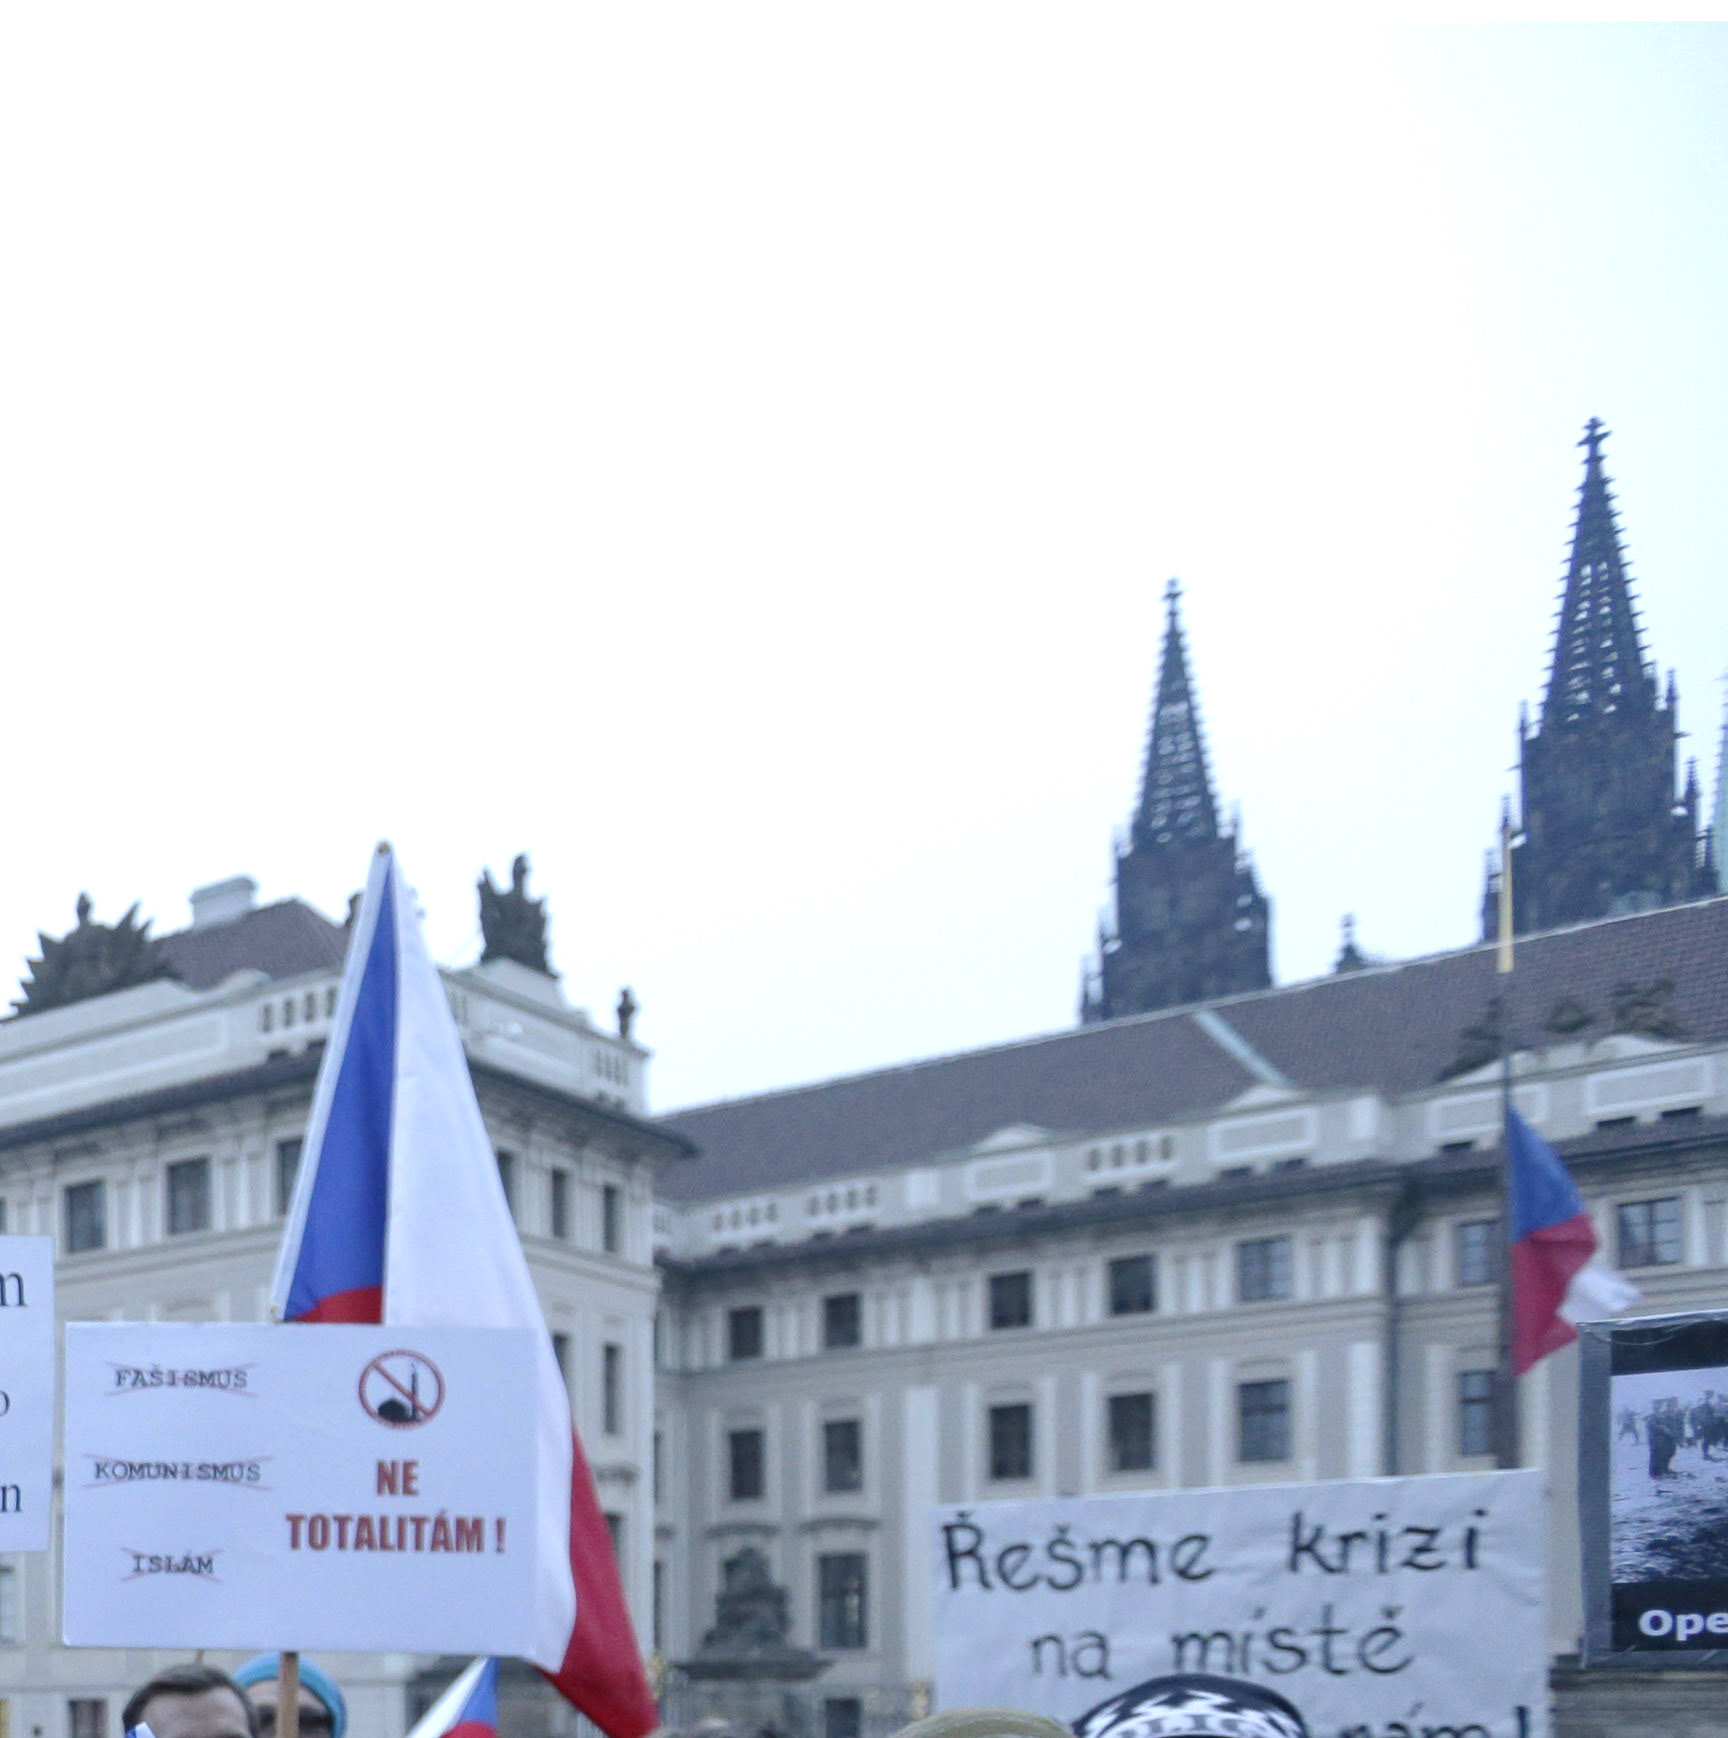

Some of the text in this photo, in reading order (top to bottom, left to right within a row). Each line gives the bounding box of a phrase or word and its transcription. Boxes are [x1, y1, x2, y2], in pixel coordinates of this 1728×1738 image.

[114, 1363, 249, 1389] FAŠISMUS
[94, 1460, 262, 1483] KOMUNISMUS
[376, 1460, 419, 1497] NE
[285, 1509, 485, 1554] TOTALITÁM
[941, 1506, 1492, 1593] Řešme krizi
[1029, 1606, 1417, 1681] na místě
